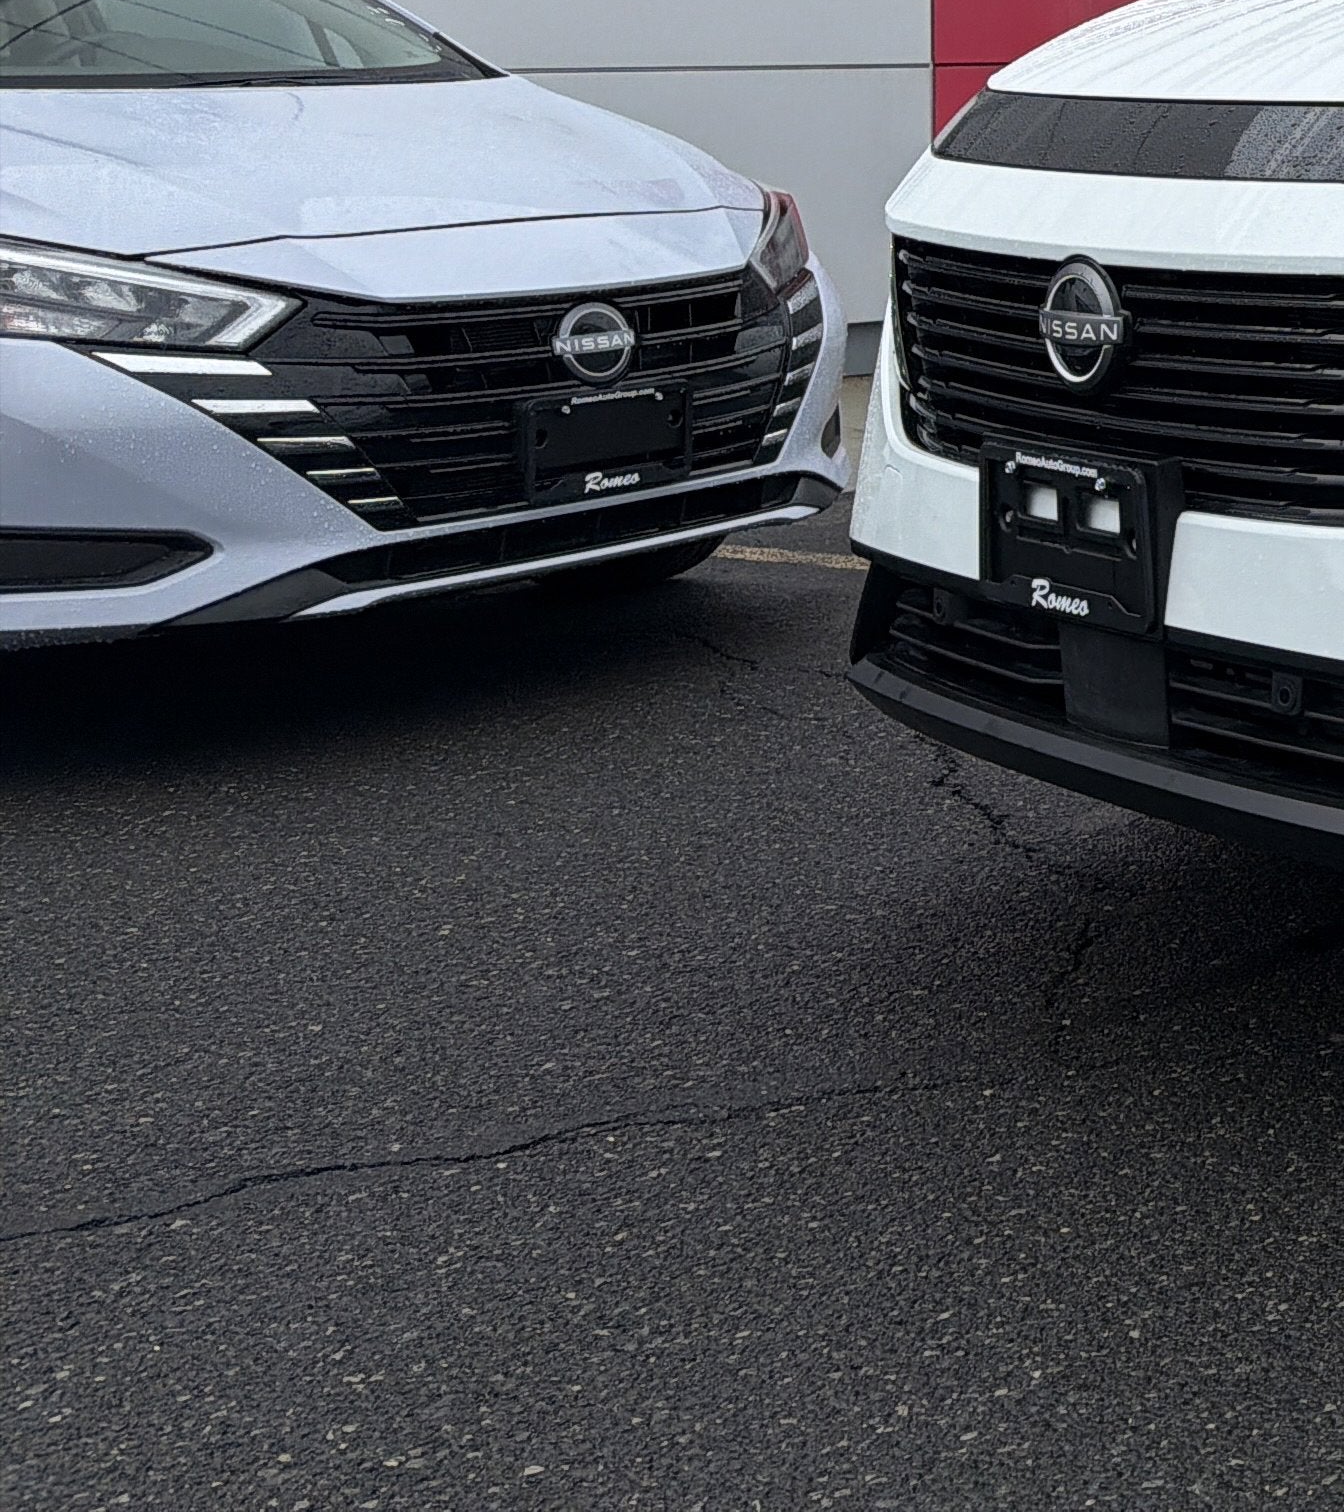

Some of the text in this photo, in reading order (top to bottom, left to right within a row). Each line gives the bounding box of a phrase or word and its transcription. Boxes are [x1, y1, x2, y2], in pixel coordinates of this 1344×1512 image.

[1039, 314, 1118, 341] NISSAN
[555, 331, 635, 354] NISSAN
[1016, 451, 1098, 479] RomeoAutoGroup.com
[584, 472, 640, 494] Romeo
[1031, 578, 1090, 617] Romeo
